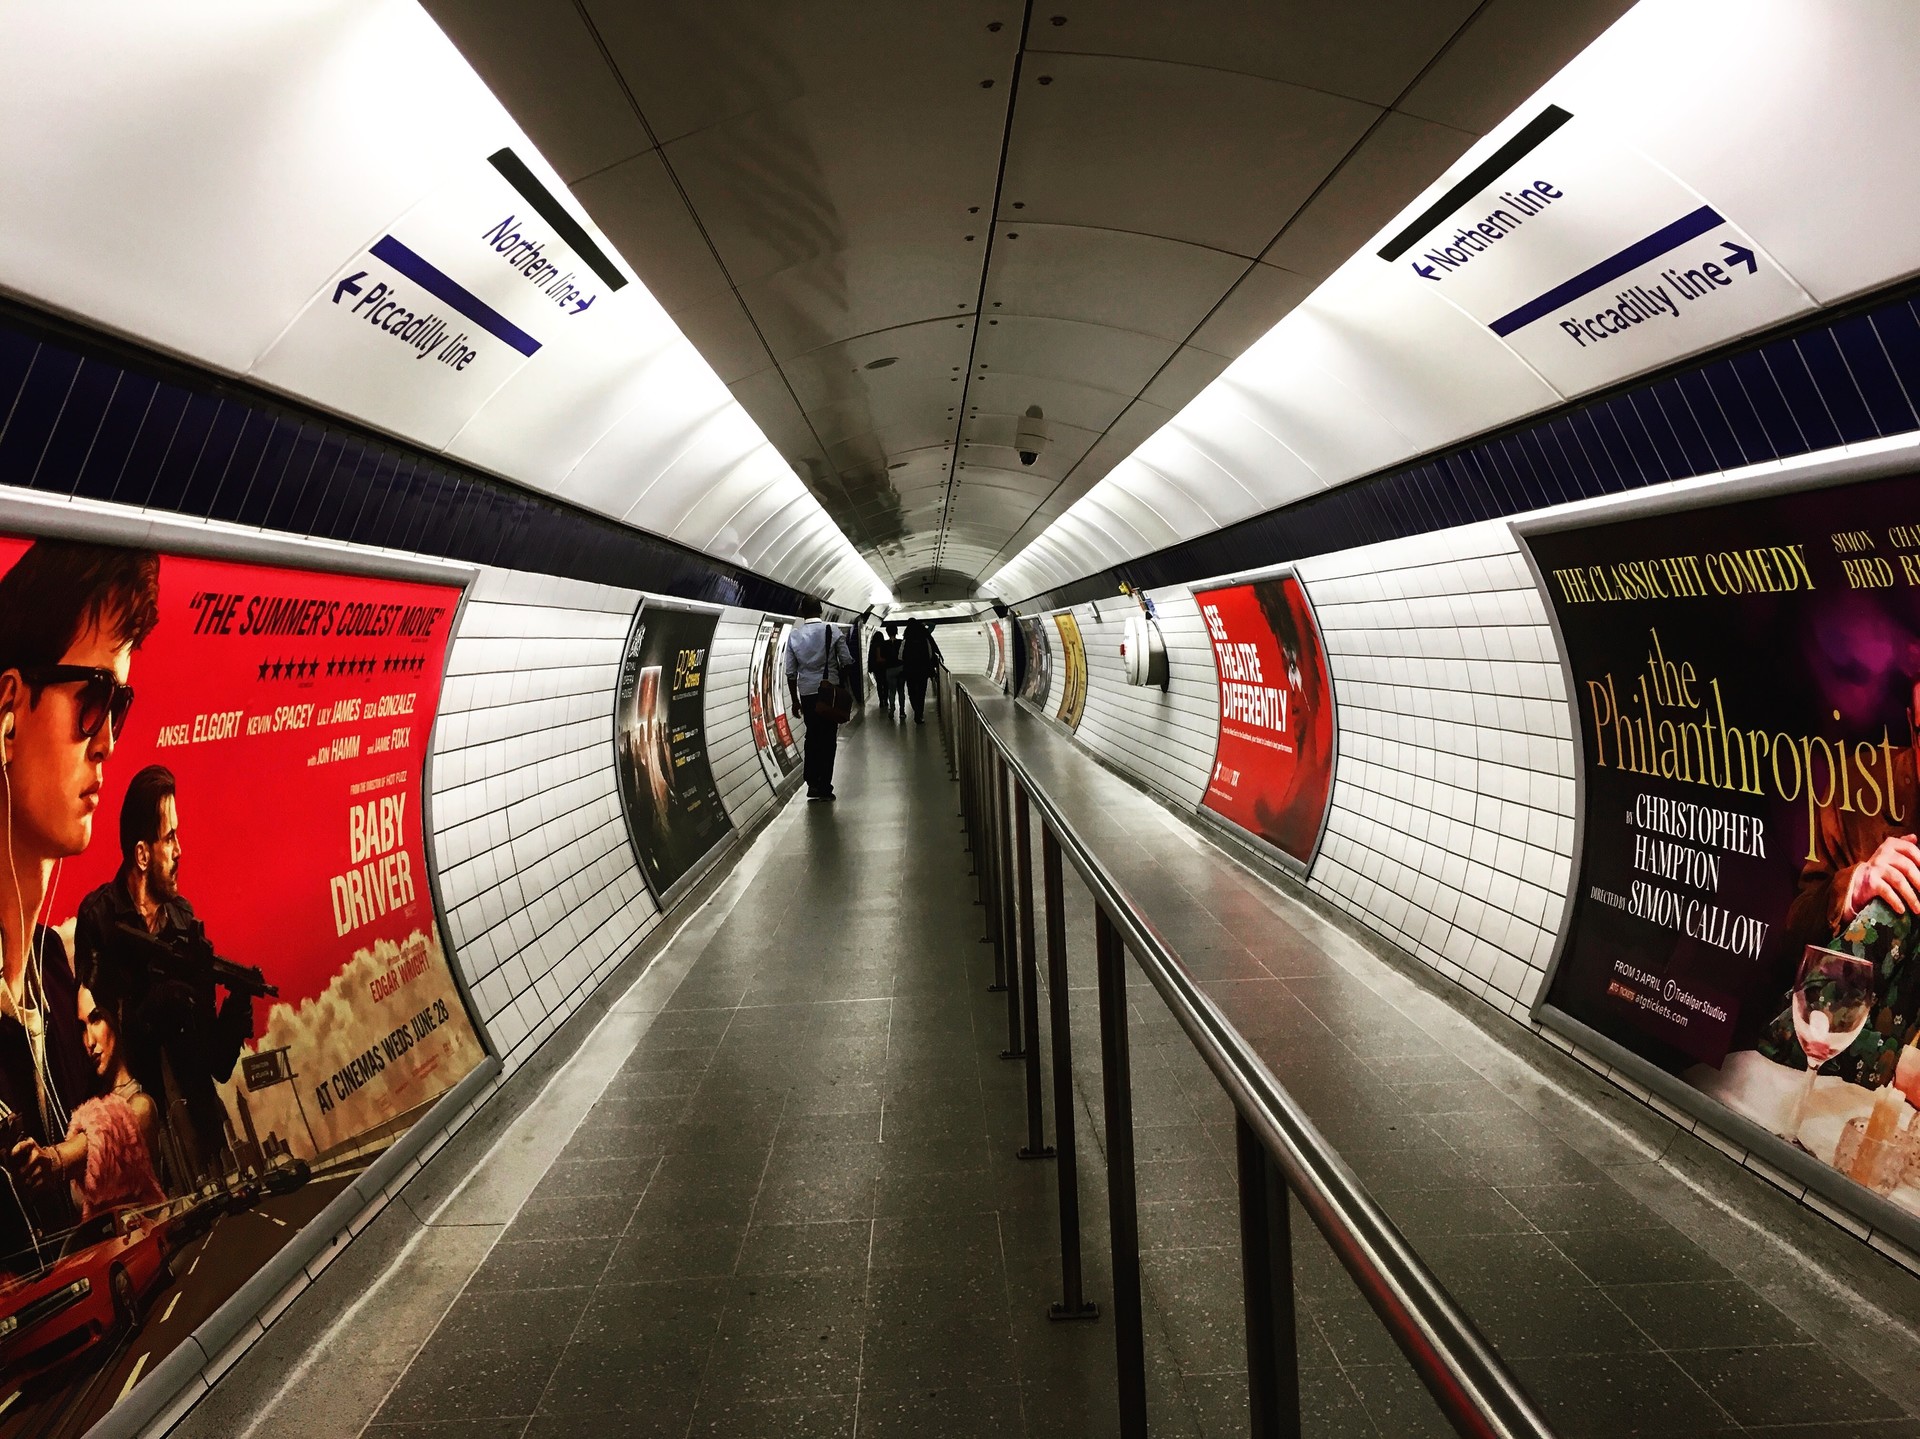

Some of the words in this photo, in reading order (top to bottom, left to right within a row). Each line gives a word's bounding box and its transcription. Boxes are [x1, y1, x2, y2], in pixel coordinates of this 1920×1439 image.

[1424, 208, 1522, 272] Northern
[1499, 180, 1563, 216] line
[482, 215, 559, 288] Northern
[545, 272, 581, 308] line
[351, 282, 449, 360] Piccadilly
[437, 333, 477, 371] line
[1559, 285, 1680, 347] Piccadilly
[1661, 262, 1732, 300] line
[1831, 530, 1875, 553] SIMON
[1553, 567, 1596, 604] THE
[1588, 559, 1669, 602] CLASSIC
[1660, 555, 1708, 598] HIT
[1705, 544, 1816, 596] COMEDY
[1841, 557, 1894, 589] BIRD
[239, 596, 339, 636] SUMMER'S
[336, 602, 403, 637] COOLEST
[1203, 605, 1228, 640] SEE
[1215, 643, 1263, 683] THEATRE
[1647, 627, 1701, 709] the
[156, 724, 190, 748] ANSEL
[192, 710, 244, 743] ELGORT
[246, 715, 272, 735] KEVIN
[272, 703, 315, 732] SPACEY
[317, 708, 332, 726] LILY
[331, 698, 361, 724] JAMES
[363, 703, 377, 719] EIZA
[377, 693, 416, 717] GONZALEZ
[1222, 681, 1287, 732] DIFFERENTLY
[316, 747, 330, 765] JON
[331, 735, 360, 762] HAMM
[373, 736, 391, 753] JAMIE
[390, 727, 411, 750] FOXX
[1586, 672, 1905, 862] Philanthropist
[350, 792, 406, 864] BABY
[1625, 810, 1634, 825] BY
[1636, 793, 1766, 859] CHRISTOPHER
[1634, 834, 1721, 893] HAMPTON
[330, 850, 415, 938] DRIVER
[1590, 886, 1618, 908] DIRECTED
[1618, 896, 1626, 911] BY
[1628, 879, 1685, 931] SIMON
[1686, 899, 1770, 961] CALLOW
[369, 970, 400, 1004] EDGAR
[398, 951, 430, 986] WRIGHT
[1608, 982, 1620, 993] ATG
[1613, 960, 1635, 979] FROM
[1634, 969, 1641, 981] 3
[1640, 972, 1661, 991] APRIL
[1635, 993, 1688, 1027] atgtickets.com
[1675, 988, 1702, 1010] Trafalgar
[1701, 1000, 1728, 1022] Studios
[315, 1081, 335, 1115] AT
[332, 1045, 386, 1101] CINEMAS
[380, 1025, 414, 1063] WEDS
[410, 1007, 437, 1042] JUNE
[433, 998, 449, 1025] 28
